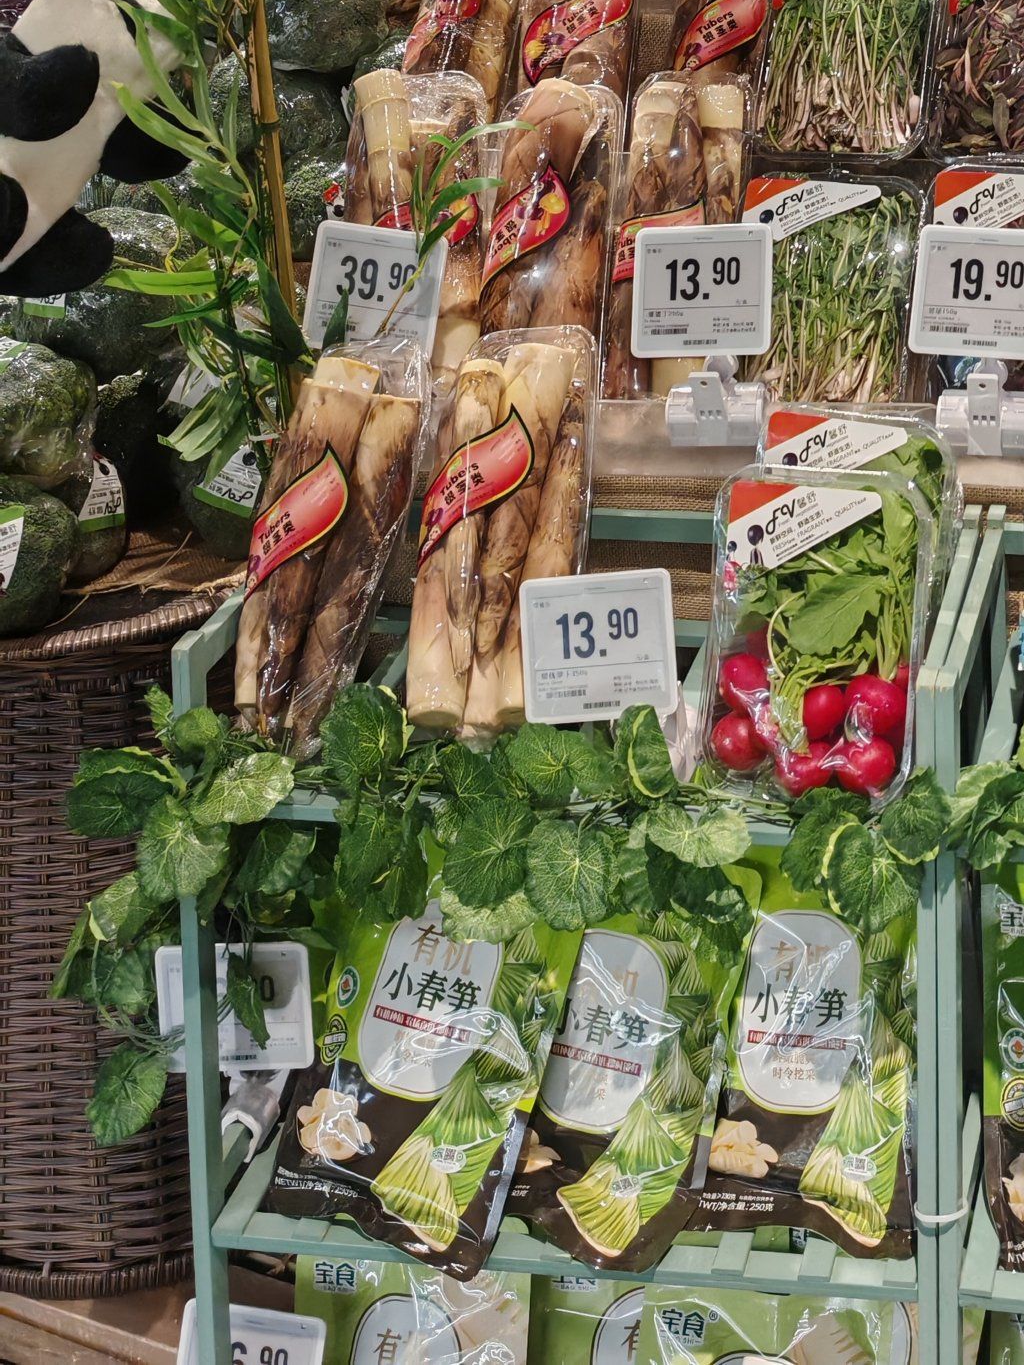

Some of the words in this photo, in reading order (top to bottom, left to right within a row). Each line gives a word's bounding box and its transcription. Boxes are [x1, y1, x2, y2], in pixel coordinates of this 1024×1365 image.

[697, 10, 734, 35] Tubers
[336, 254, 418, 303] 39.90
[665, 256, 741, 302] 13.90
[950, 257, 1024, 302] 19.90
[440, 460, 480, 498] Tubers
[257, 510, 291, 543] Tubers
[765, 498, 796, 535] FV
[555, 606, 639, 661] 13.90
[411, 923, 473, 975] 有机
[382, 961, 483, 1013] 小春笋
[315, 1261, 357, 1287] 宝食
[662, 1308, 705, 1339] 宝食
